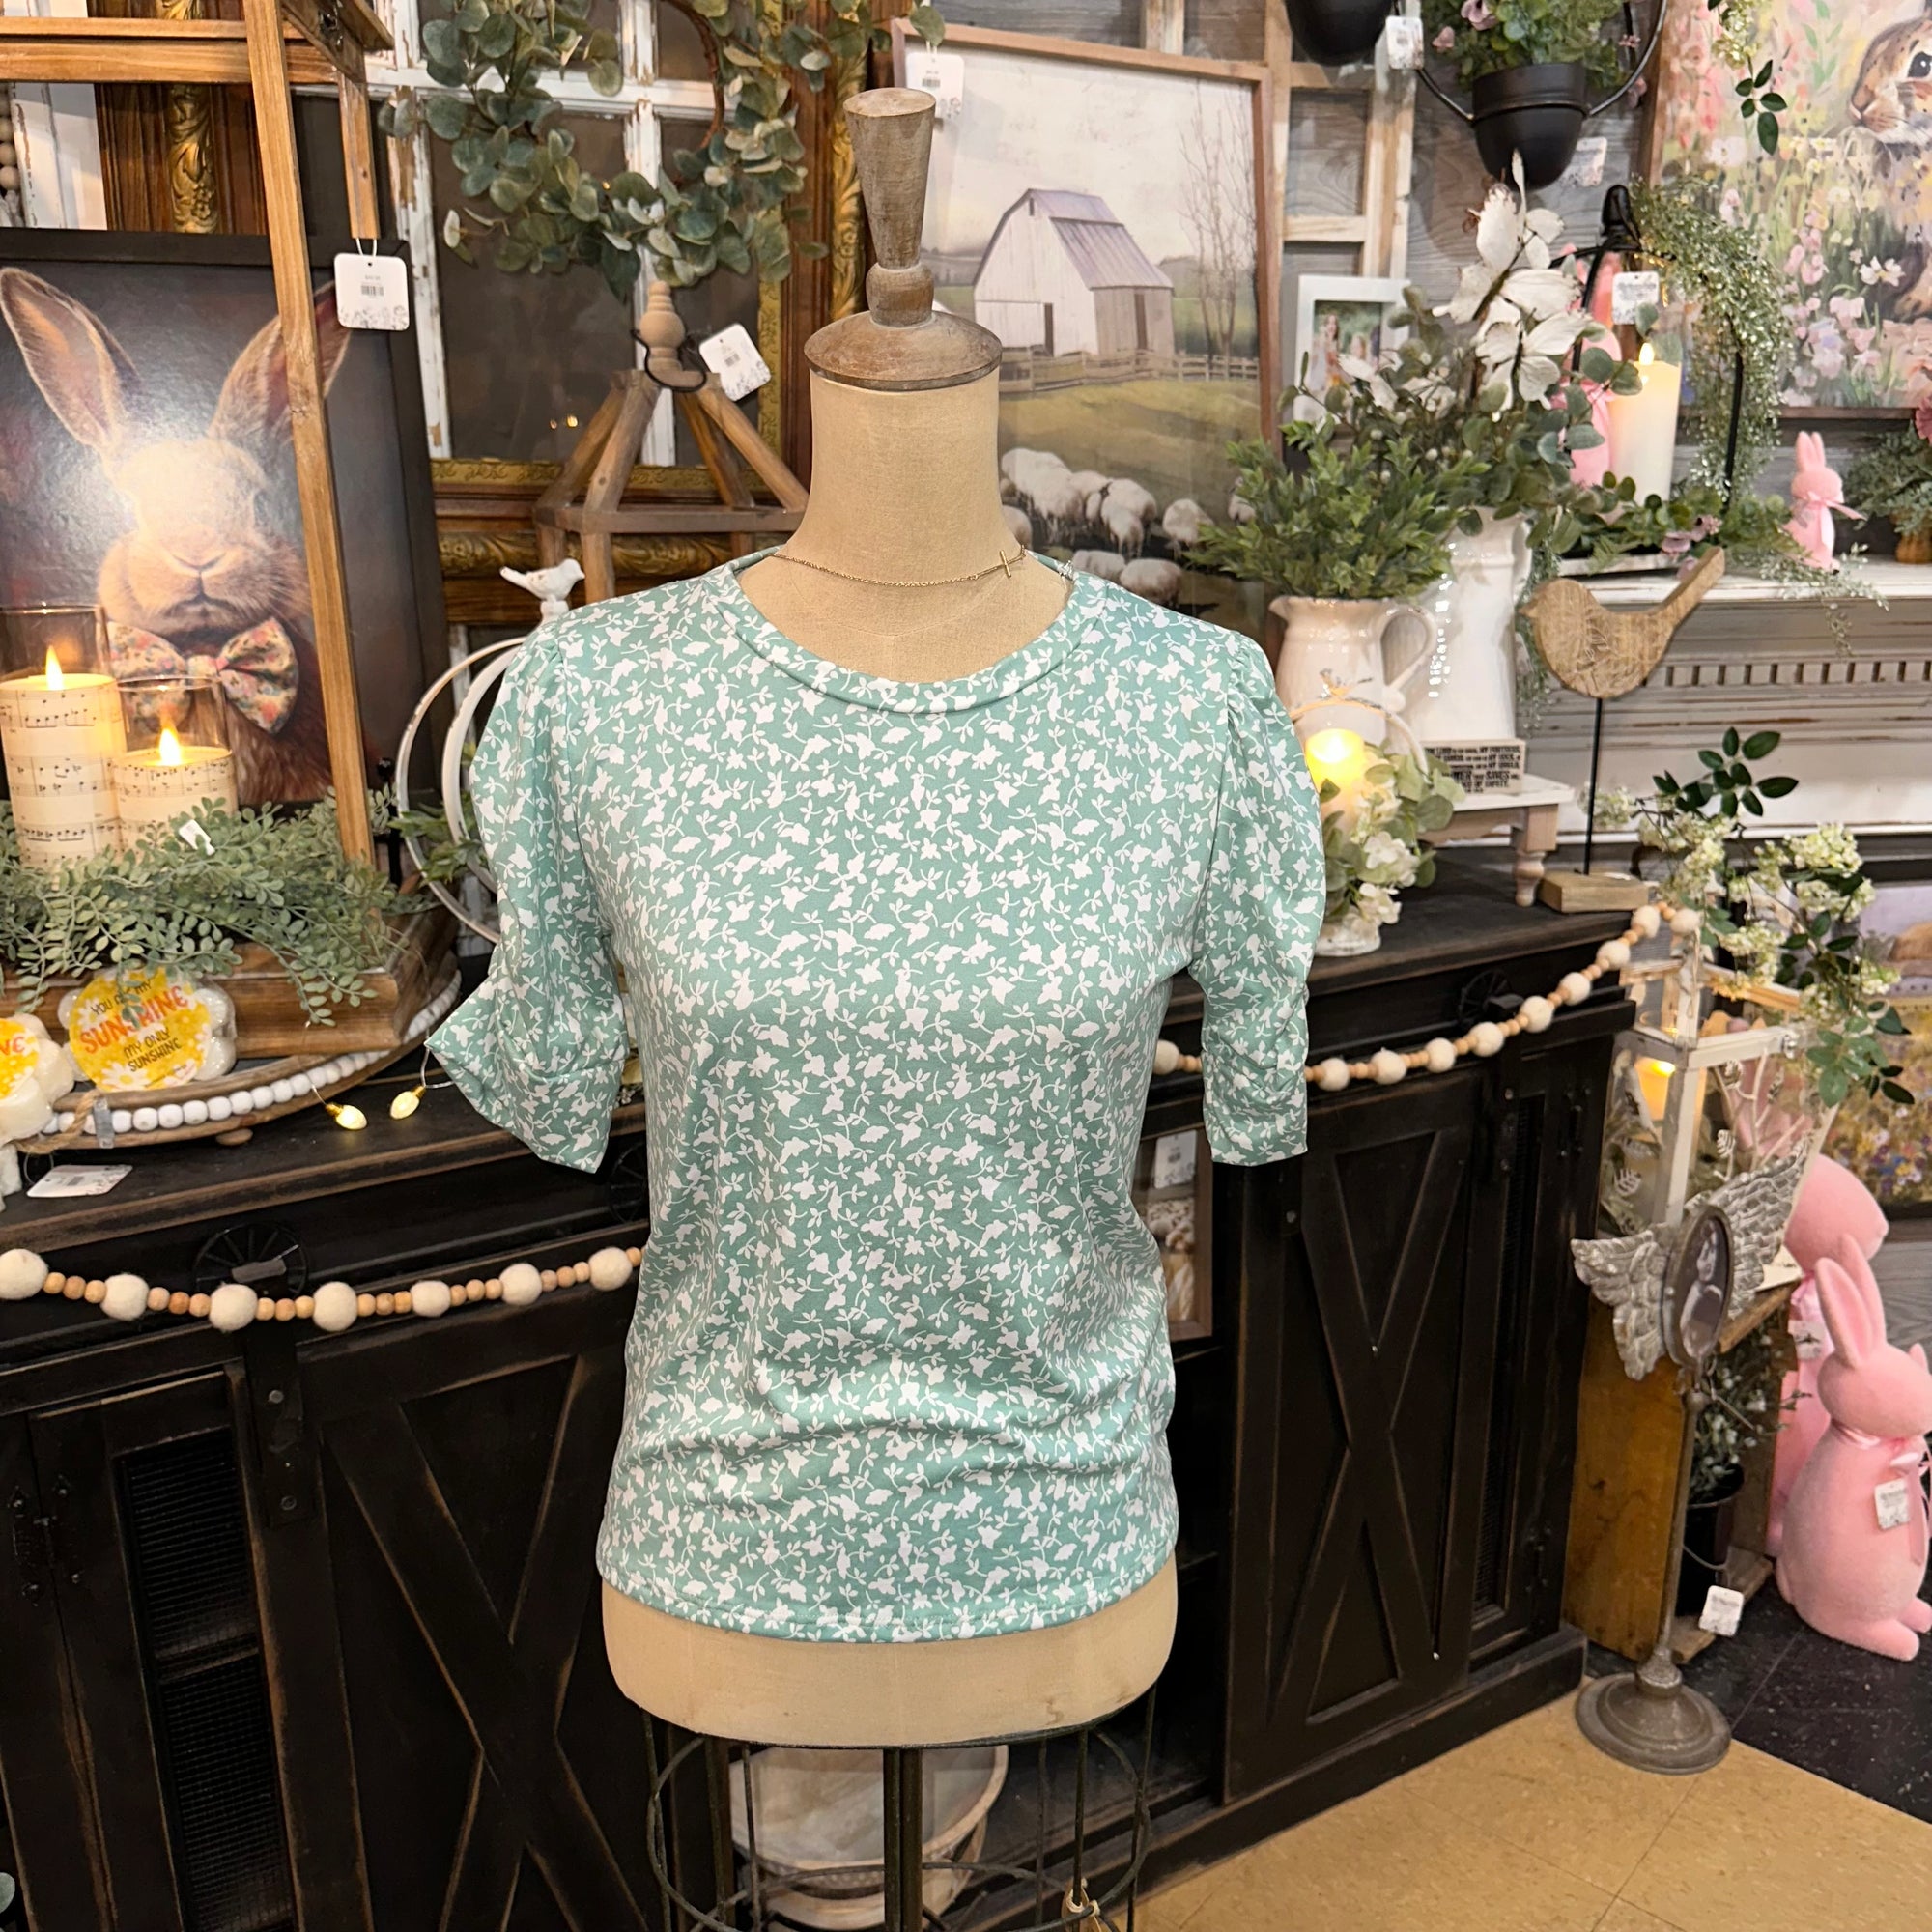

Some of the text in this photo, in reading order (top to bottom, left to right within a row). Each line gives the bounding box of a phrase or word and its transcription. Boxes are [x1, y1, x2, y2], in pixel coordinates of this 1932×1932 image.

[91, 998, 113, 1015] YOU
[123, 1027, 170, 1059] MY ONLY
[128, 1037, 182, 1072] SUNSHINE
